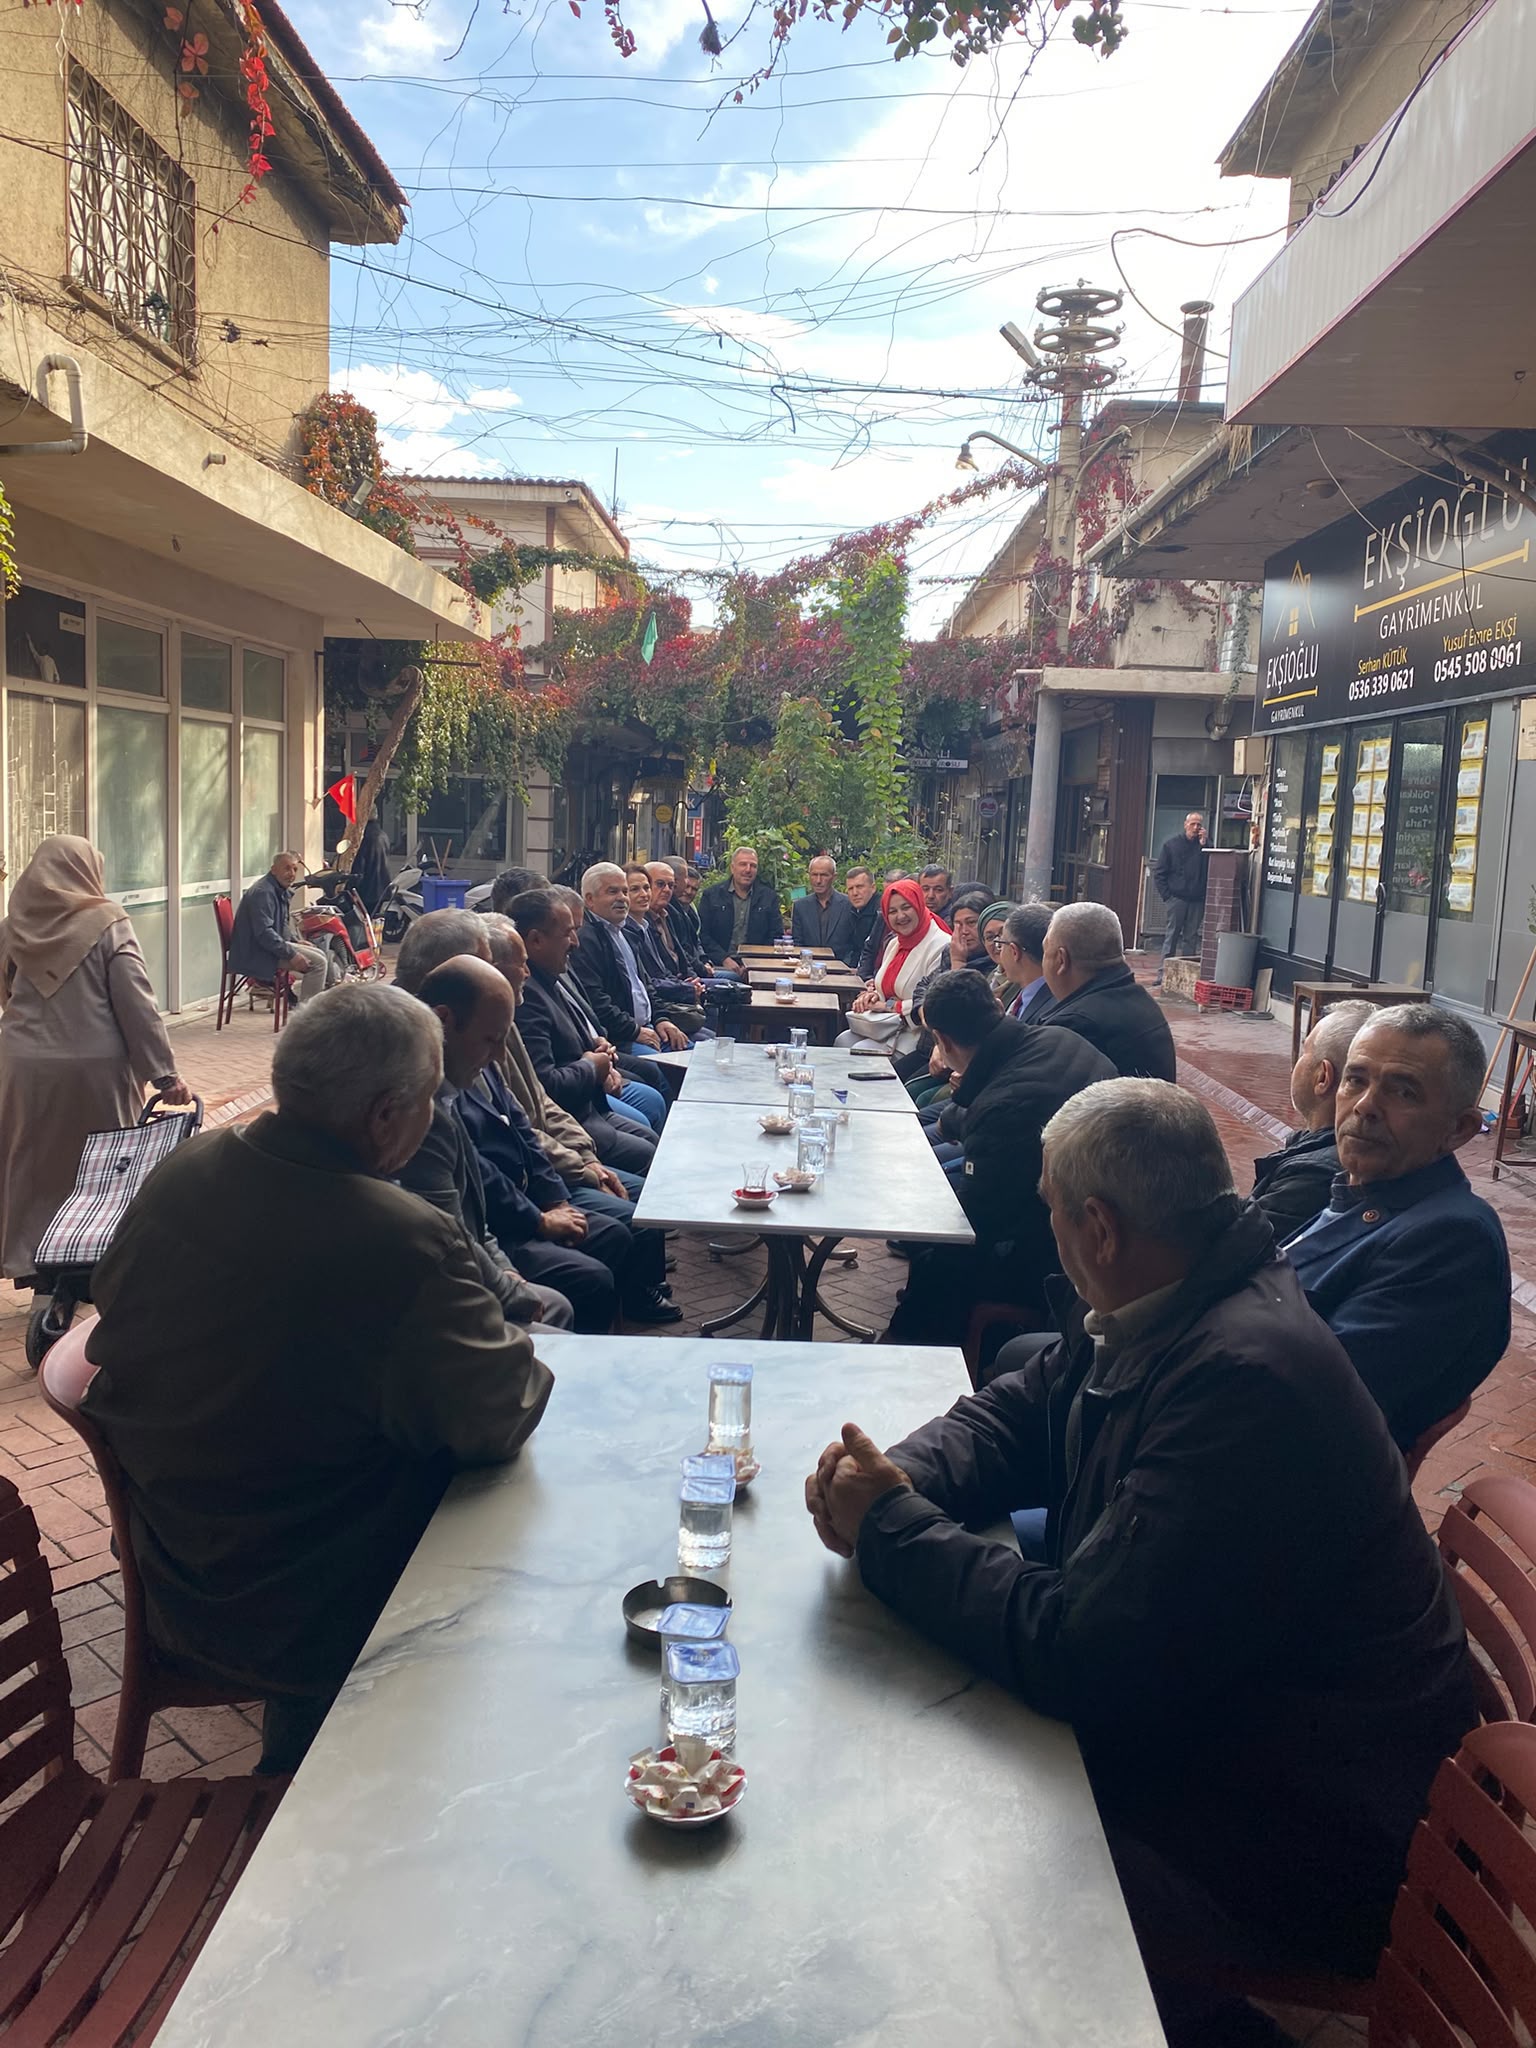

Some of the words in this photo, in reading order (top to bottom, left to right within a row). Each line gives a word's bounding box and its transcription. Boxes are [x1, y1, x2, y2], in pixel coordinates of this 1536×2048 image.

[1364, 457, 1529, 591] EKŞİOĞLU
[1379, 583, 1484, 640] GAYRİMENKUL
[1442, 629, 1468, 653] Yusuf
[1468, 627, 1493, 647] Emre
[1494, 612, 1518, 643] EKŞİ
[1266, 639, 1319, 694] EKŞİOĞLU
[1357, 654, 1382, 676] Serhan
[1382, 645, 1408, 671] KÜTÜK
[1433, 654, 1462, 683] 0545
[1463, 649, 1487, 676] 508
[1490, 640, 1523, 671] 0061
[1348, 678, 1370, 701] 0536
[1371, 672, 1389, 697] 339
[1390, 667, 1415, 693] 0621
